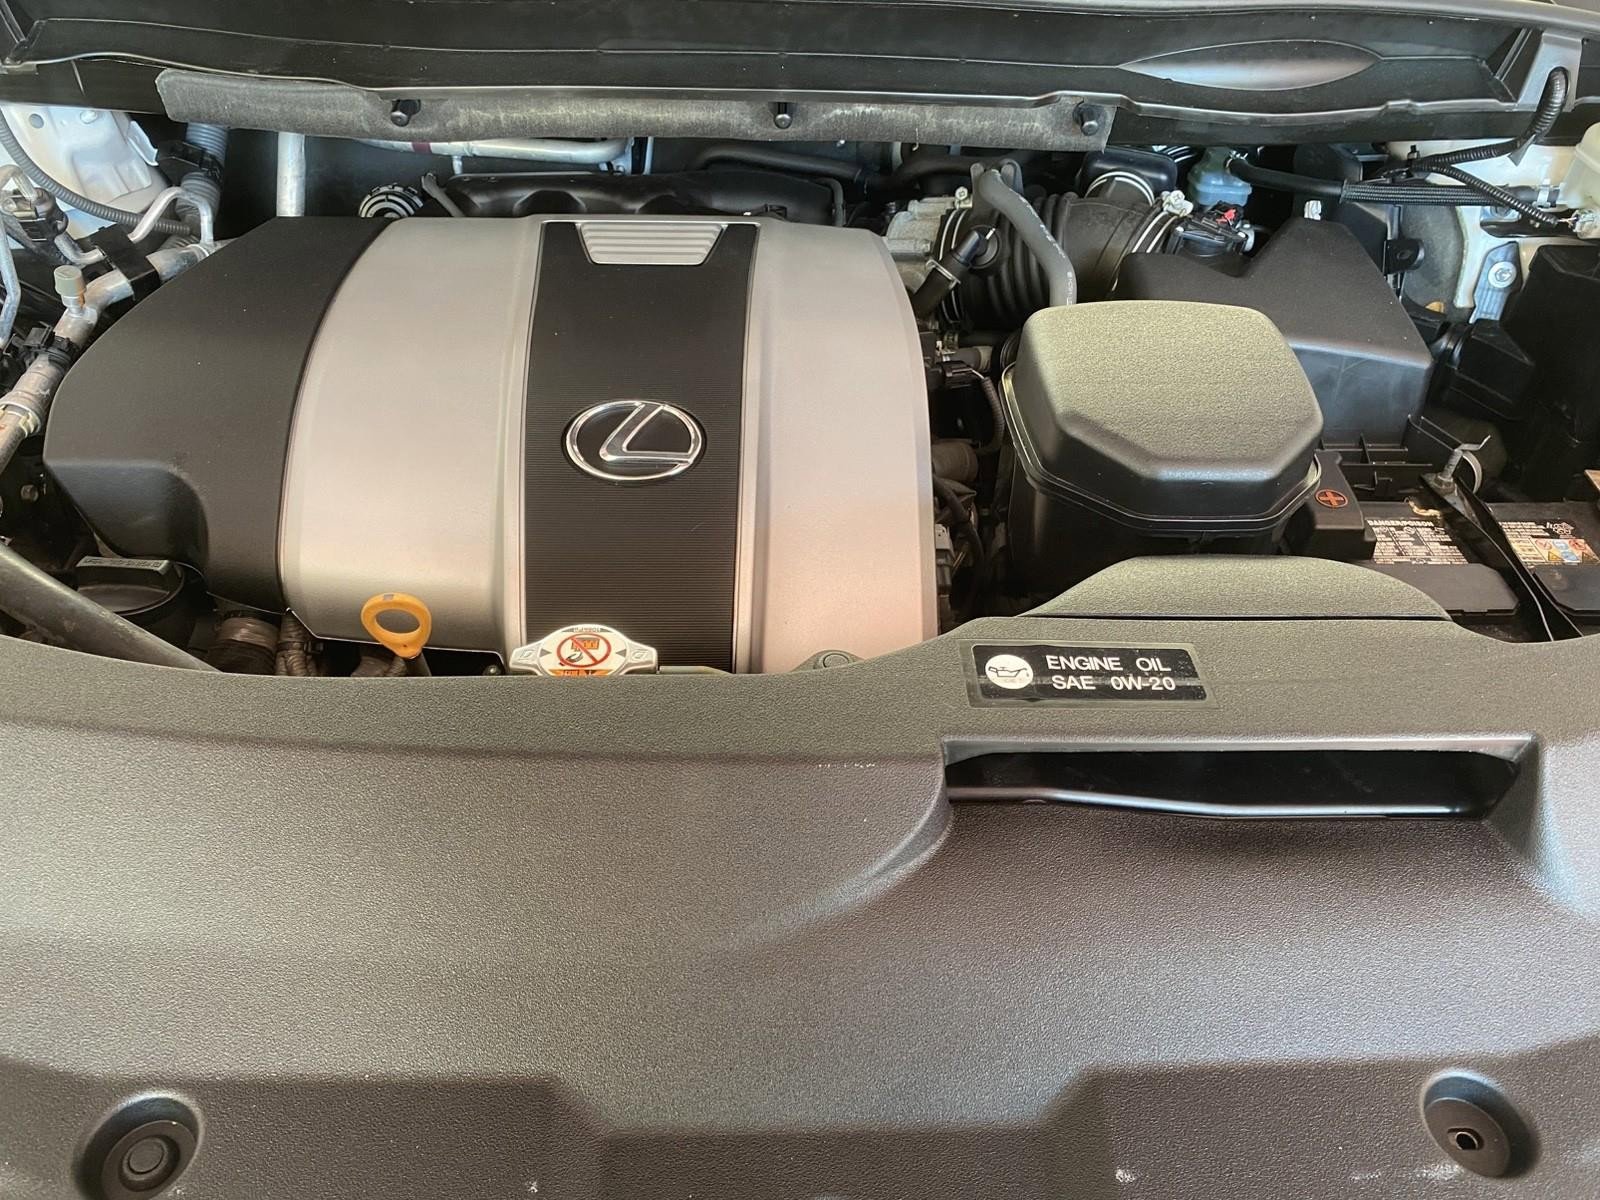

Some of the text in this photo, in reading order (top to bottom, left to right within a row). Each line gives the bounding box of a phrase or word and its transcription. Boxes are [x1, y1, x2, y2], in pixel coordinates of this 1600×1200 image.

[1046, 655, 1172, 671] ENGINE OIL
[1052, 675, 1176, 691] SAE 0W-20
